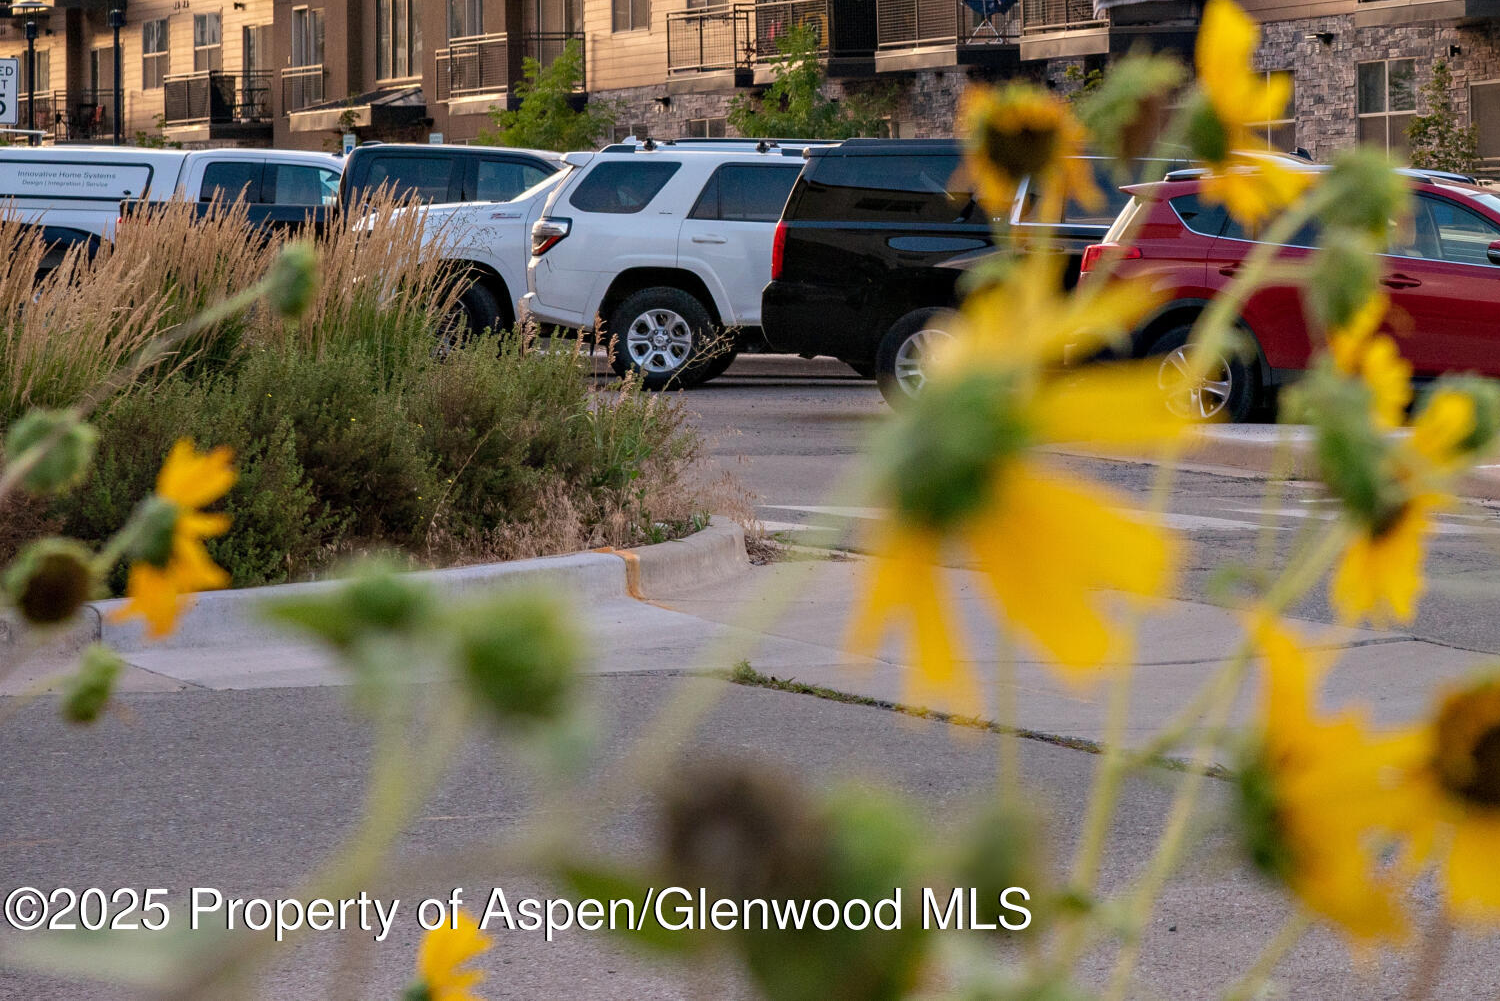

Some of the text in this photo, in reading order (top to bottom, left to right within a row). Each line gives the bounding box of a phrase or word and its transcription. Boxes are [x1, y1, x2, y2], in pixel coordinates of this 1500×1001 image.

[17, 170, 116, 180] Innovative Home Systems
